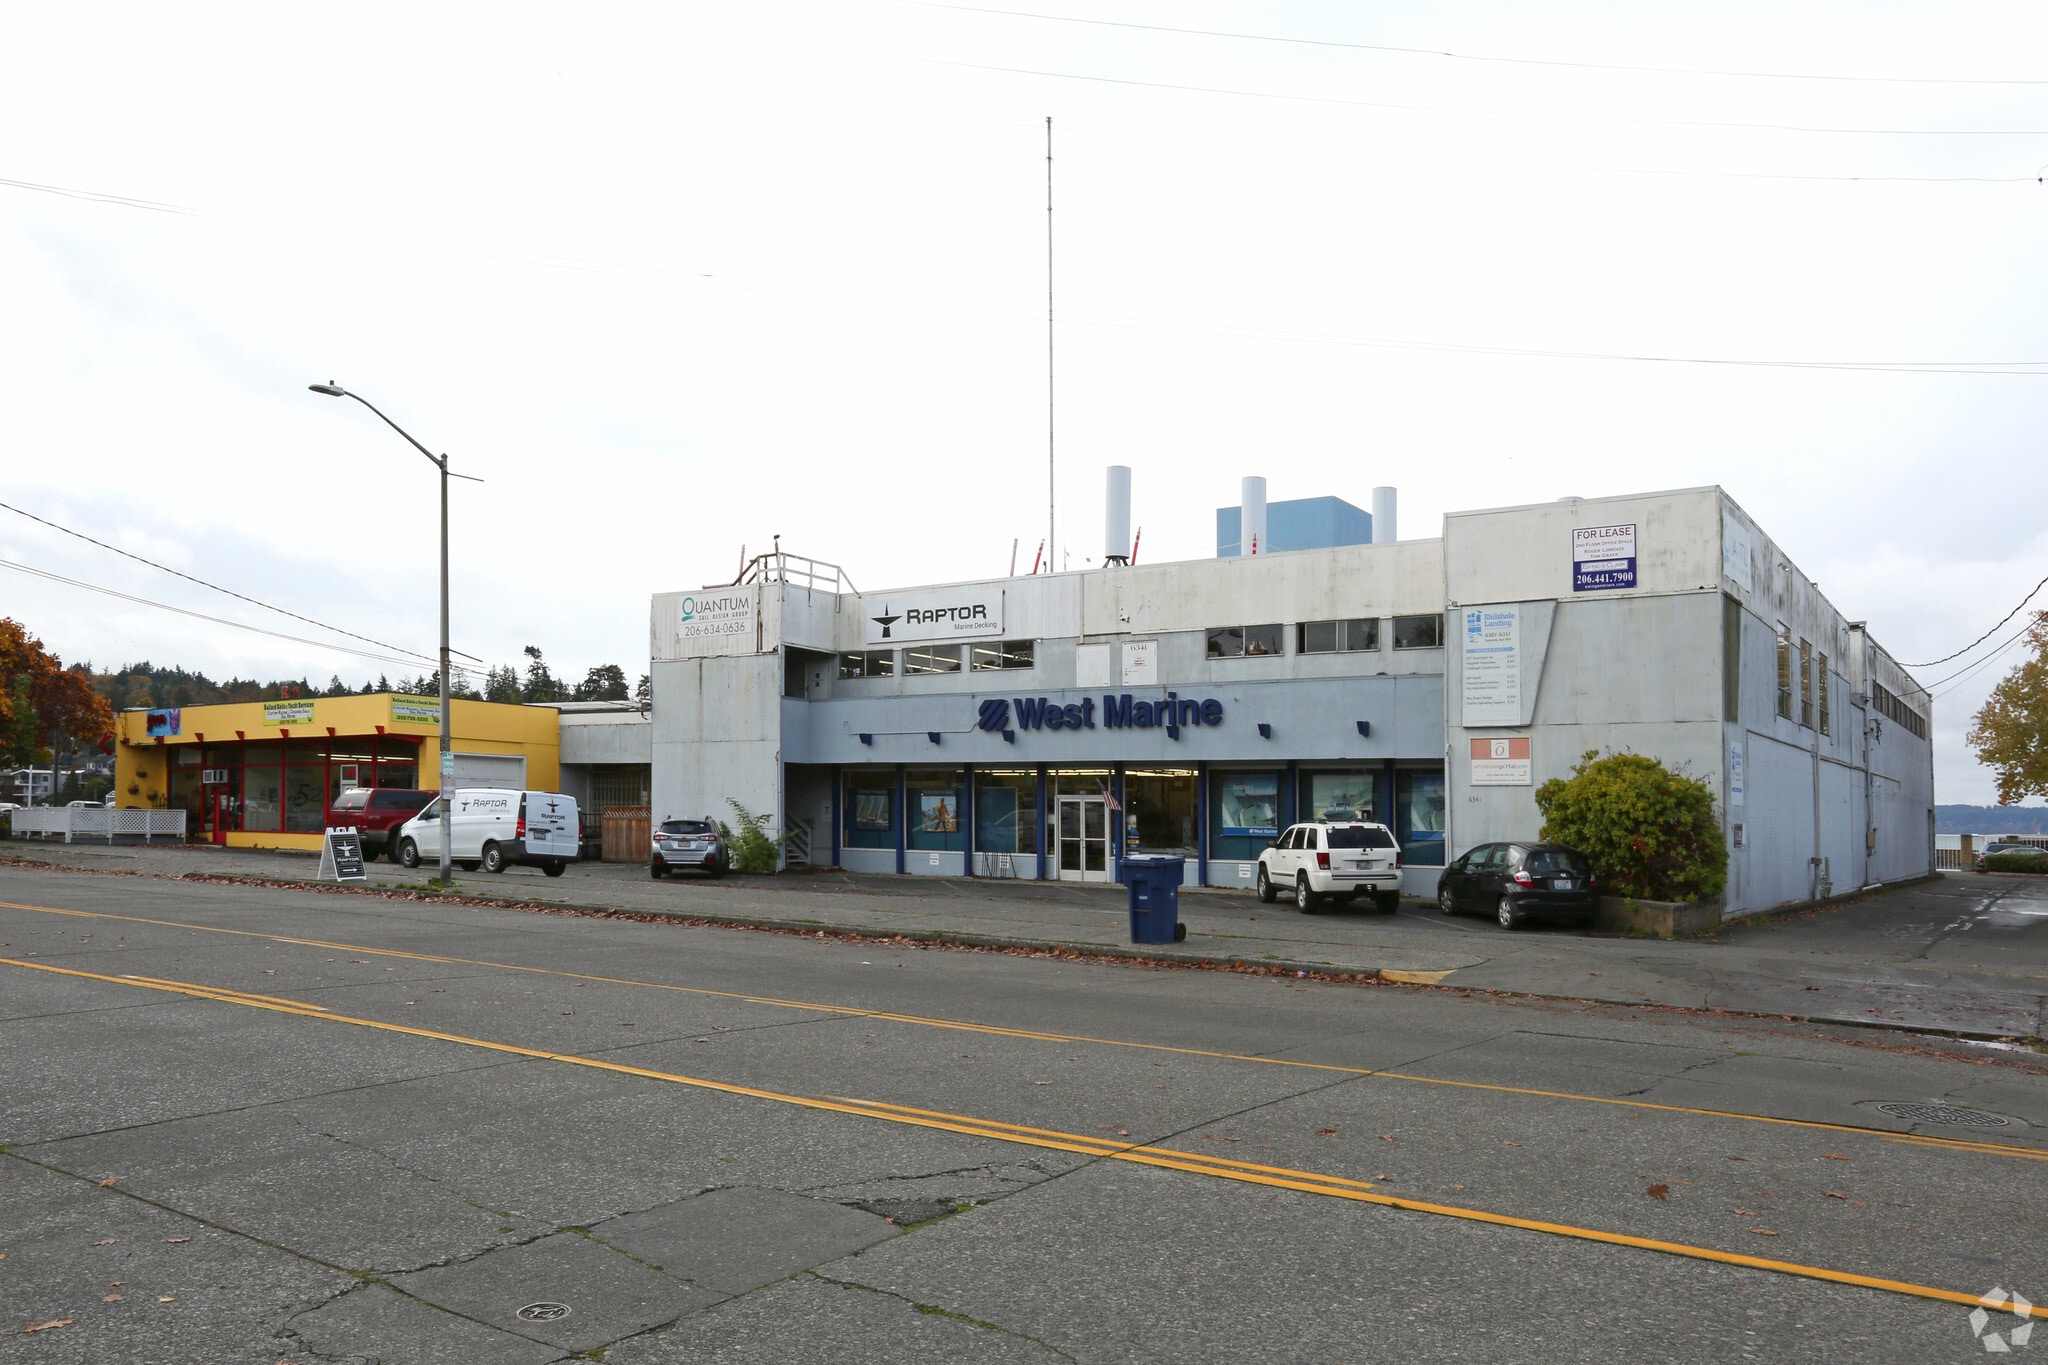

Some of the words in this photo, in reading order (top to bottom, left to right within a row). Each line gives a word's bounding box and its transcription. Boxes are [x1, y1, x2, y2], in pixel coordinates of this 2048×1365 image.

[1577, 530, 1597, 540] FOR
[1600, 527, 1632, 538] LEASE
[1577, 572, 1634, 584] 206.441.7900
[682, 597, 749, 621] QUANTUM
[907, 604, 987, 625] RAPTOR
[712, 612, 730, 620] DESIGN
[732, 610, 749, 618] GROUP
[1484, 612, 1516, 621] Shilshole
[685, 621, 746, 637] 206-634-0636
[974, 621, 998, 630] Decking
[1484, 620, 1513, 629] Landing
[1013, 697, 1095, 730] West
[1103, 692, 1222, 730] Marine
[473, 799, 508, 808] RAPTOR
[541, 813, 567, 821] RAPTOR
